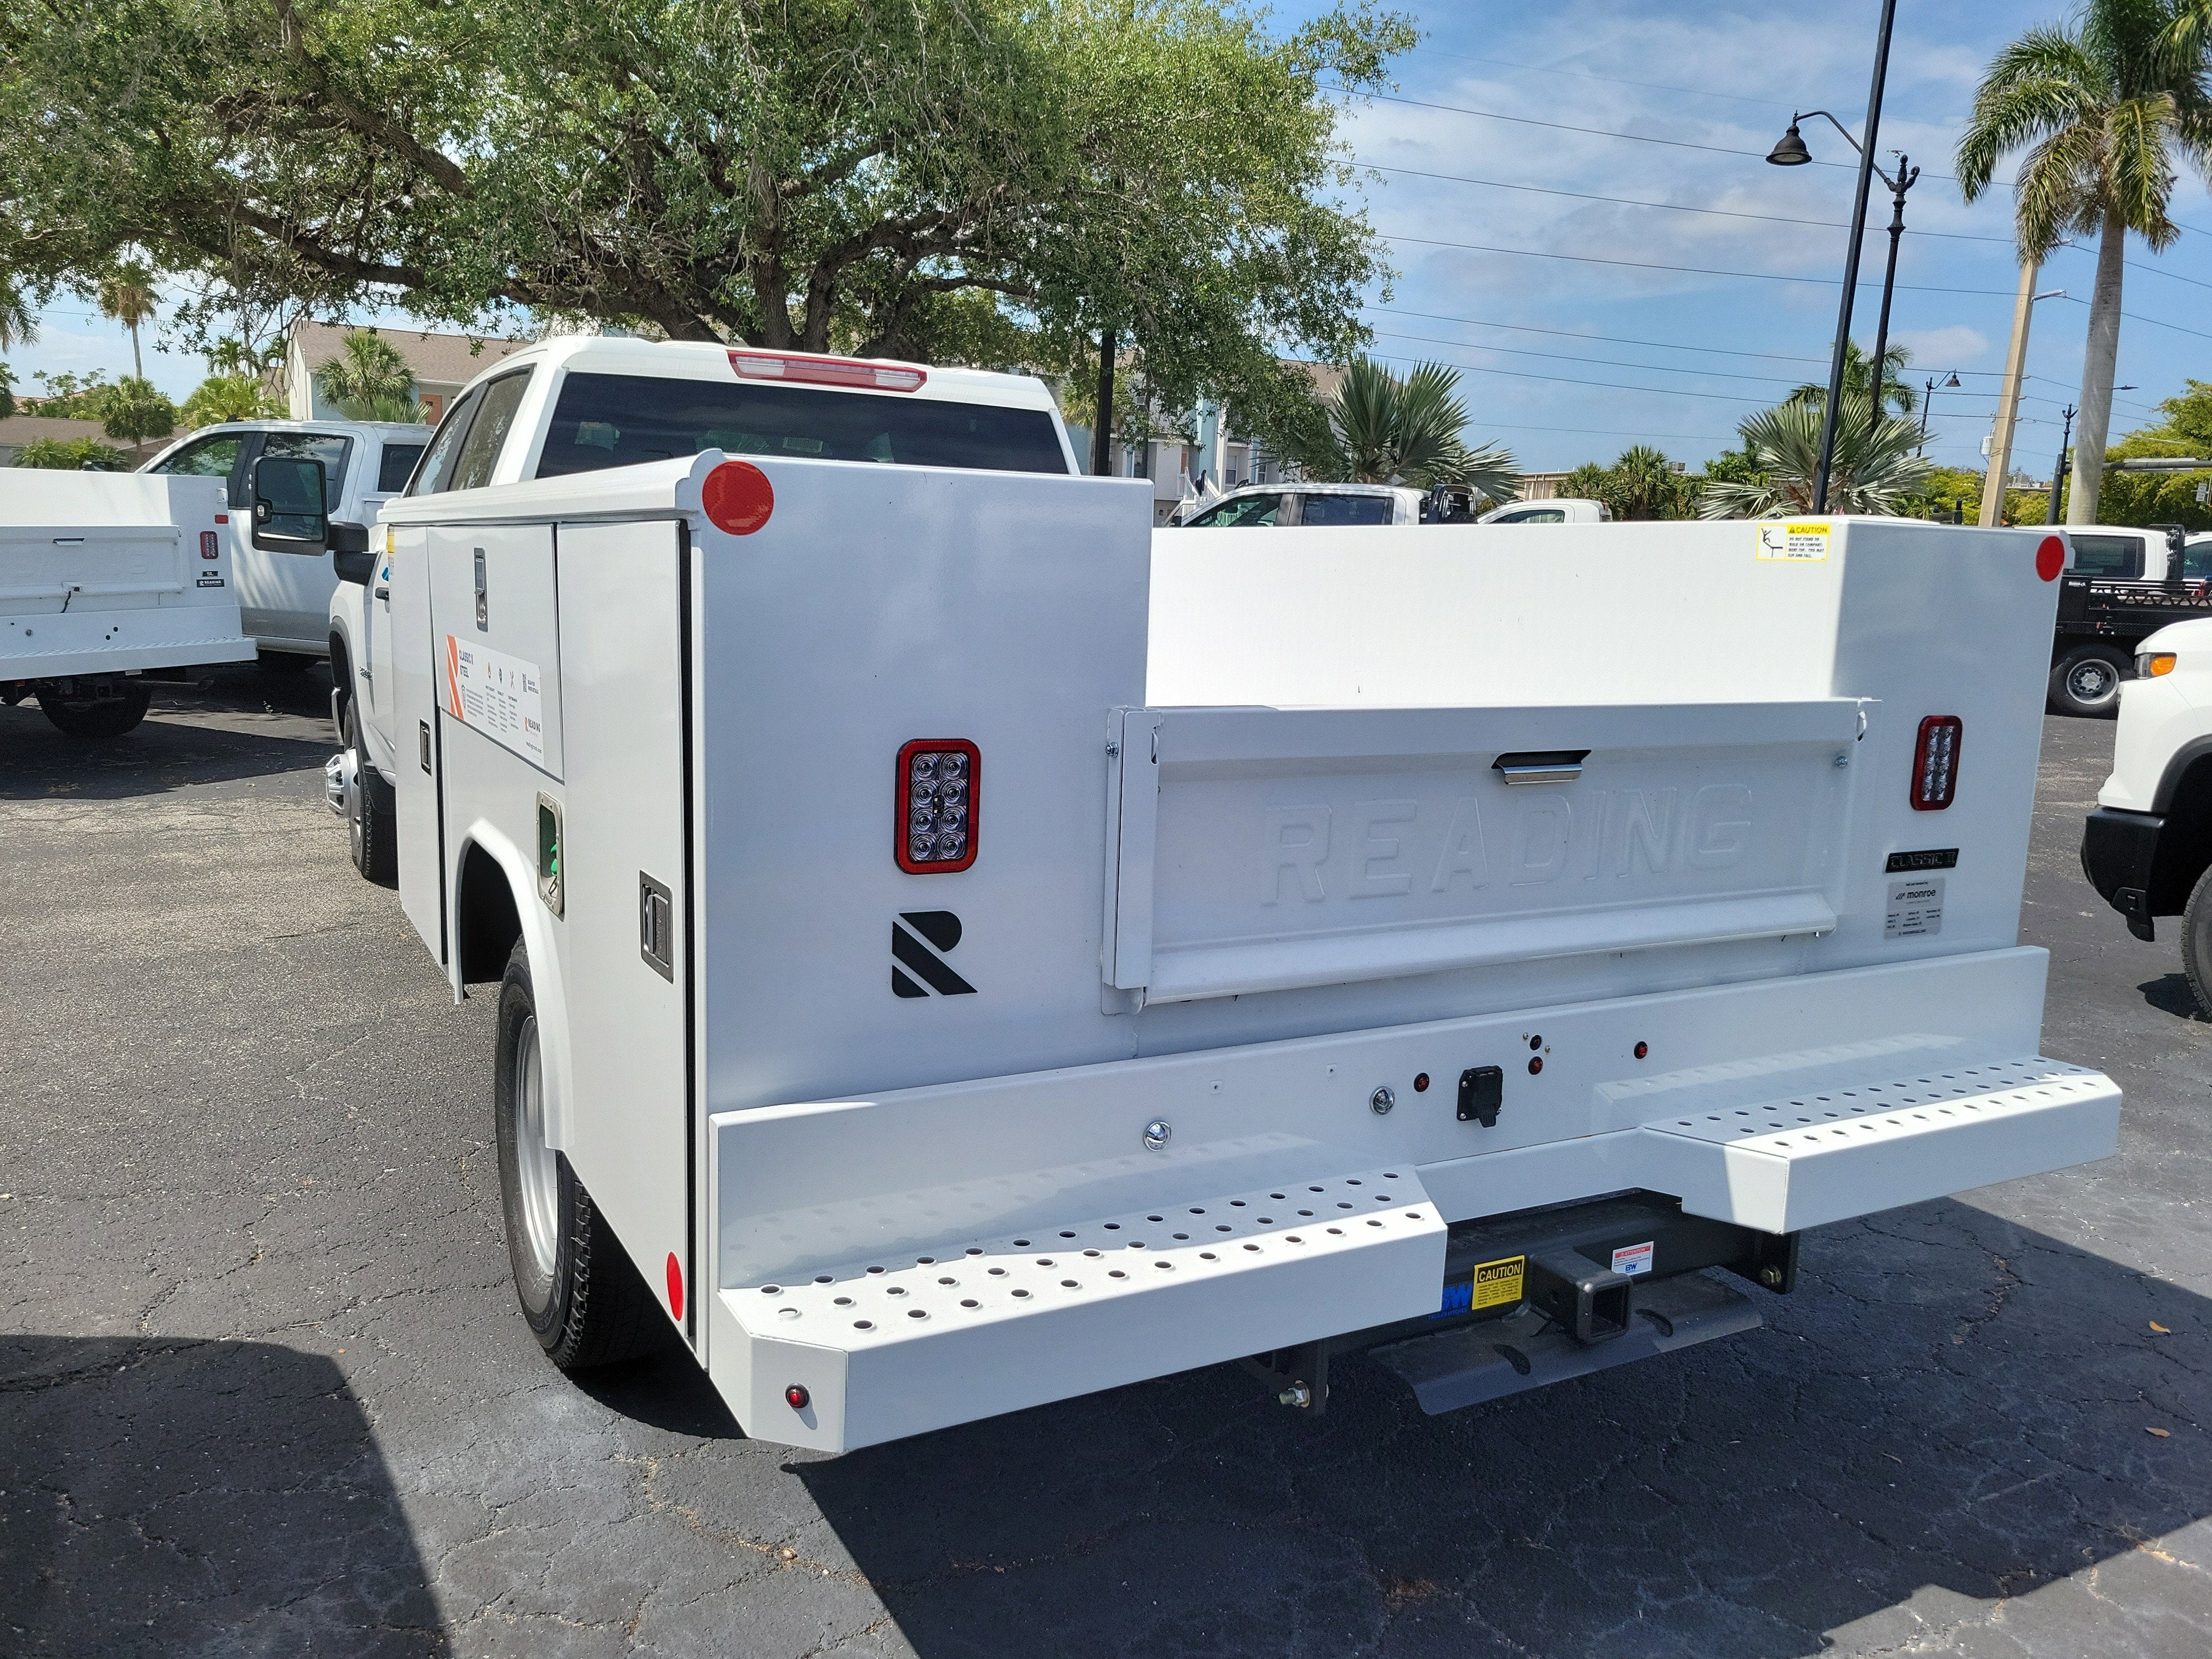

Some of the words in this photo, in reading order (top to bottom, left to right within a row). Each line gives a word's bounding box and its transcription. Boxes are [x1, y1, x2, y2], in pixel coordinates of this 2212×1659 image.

[460, 664, 469, 678] STEEL
[1259, 783, 1752, 907] READING
[1906, 889, 1936, 899] monroe
[1479, 1263, 1521, 1282] CAUTION
